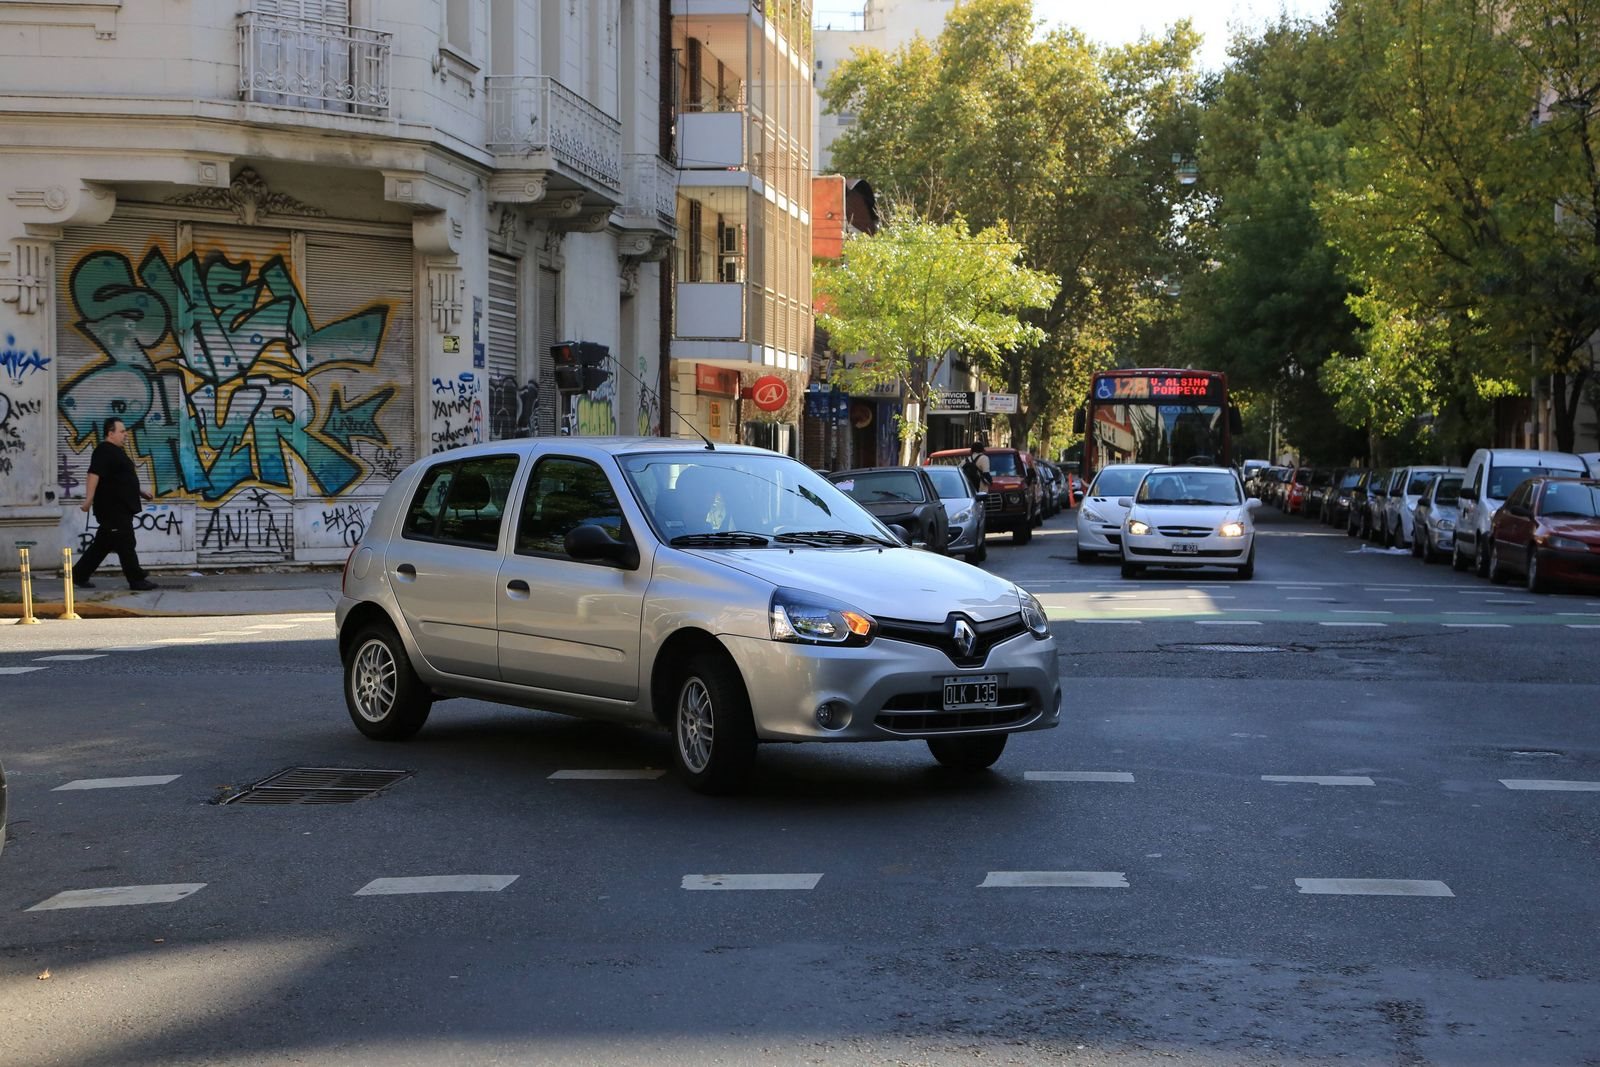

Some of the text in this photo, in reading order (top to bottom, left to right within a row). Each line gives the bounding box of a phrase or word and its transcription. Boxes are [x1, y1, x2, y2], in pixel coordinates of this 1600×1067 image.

[1153, 387, 1206, 395] POMPEYA
[946, 684, 996, 704] OLK 135
